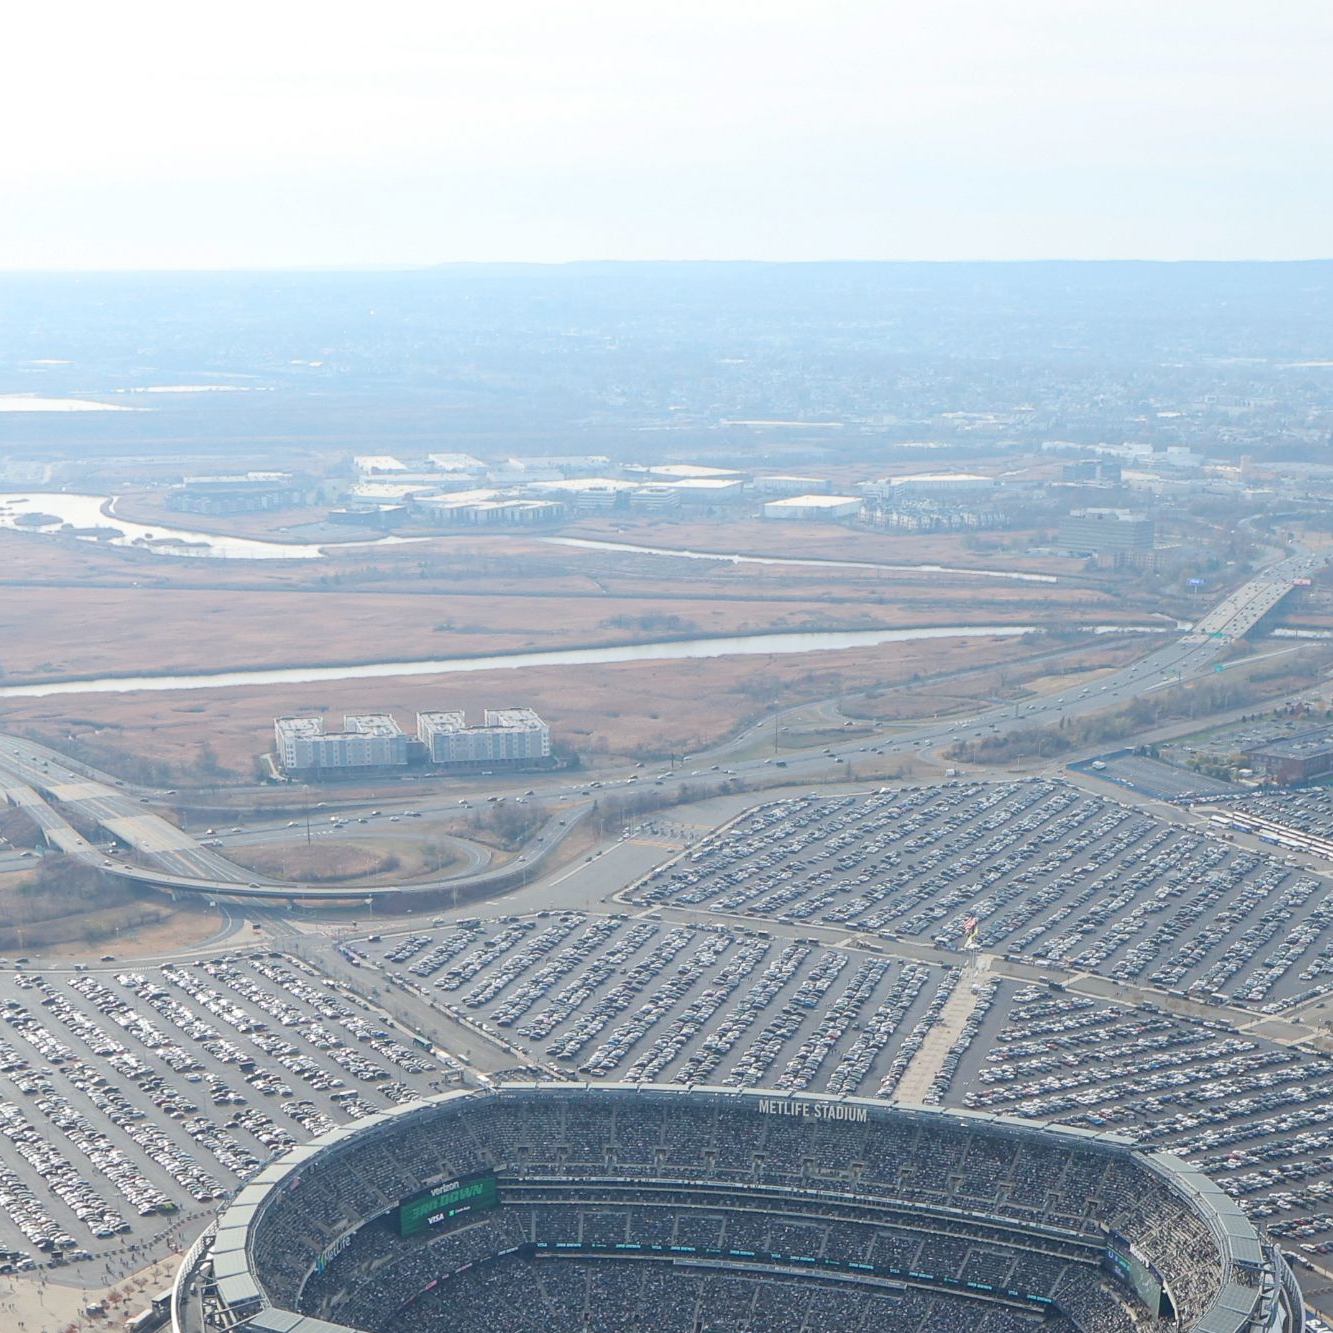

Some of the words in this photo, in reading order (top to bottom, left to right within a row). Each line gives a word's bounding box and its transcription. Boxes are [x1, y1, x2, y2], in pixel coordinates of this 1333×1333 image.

[759, 1100, 809, 1116] METLIFE
[814, 1104, 867, 1122] STADIUM
[430, 1181, 459, 1196] verizon
[428, 1213, 444, 1224] VISA
